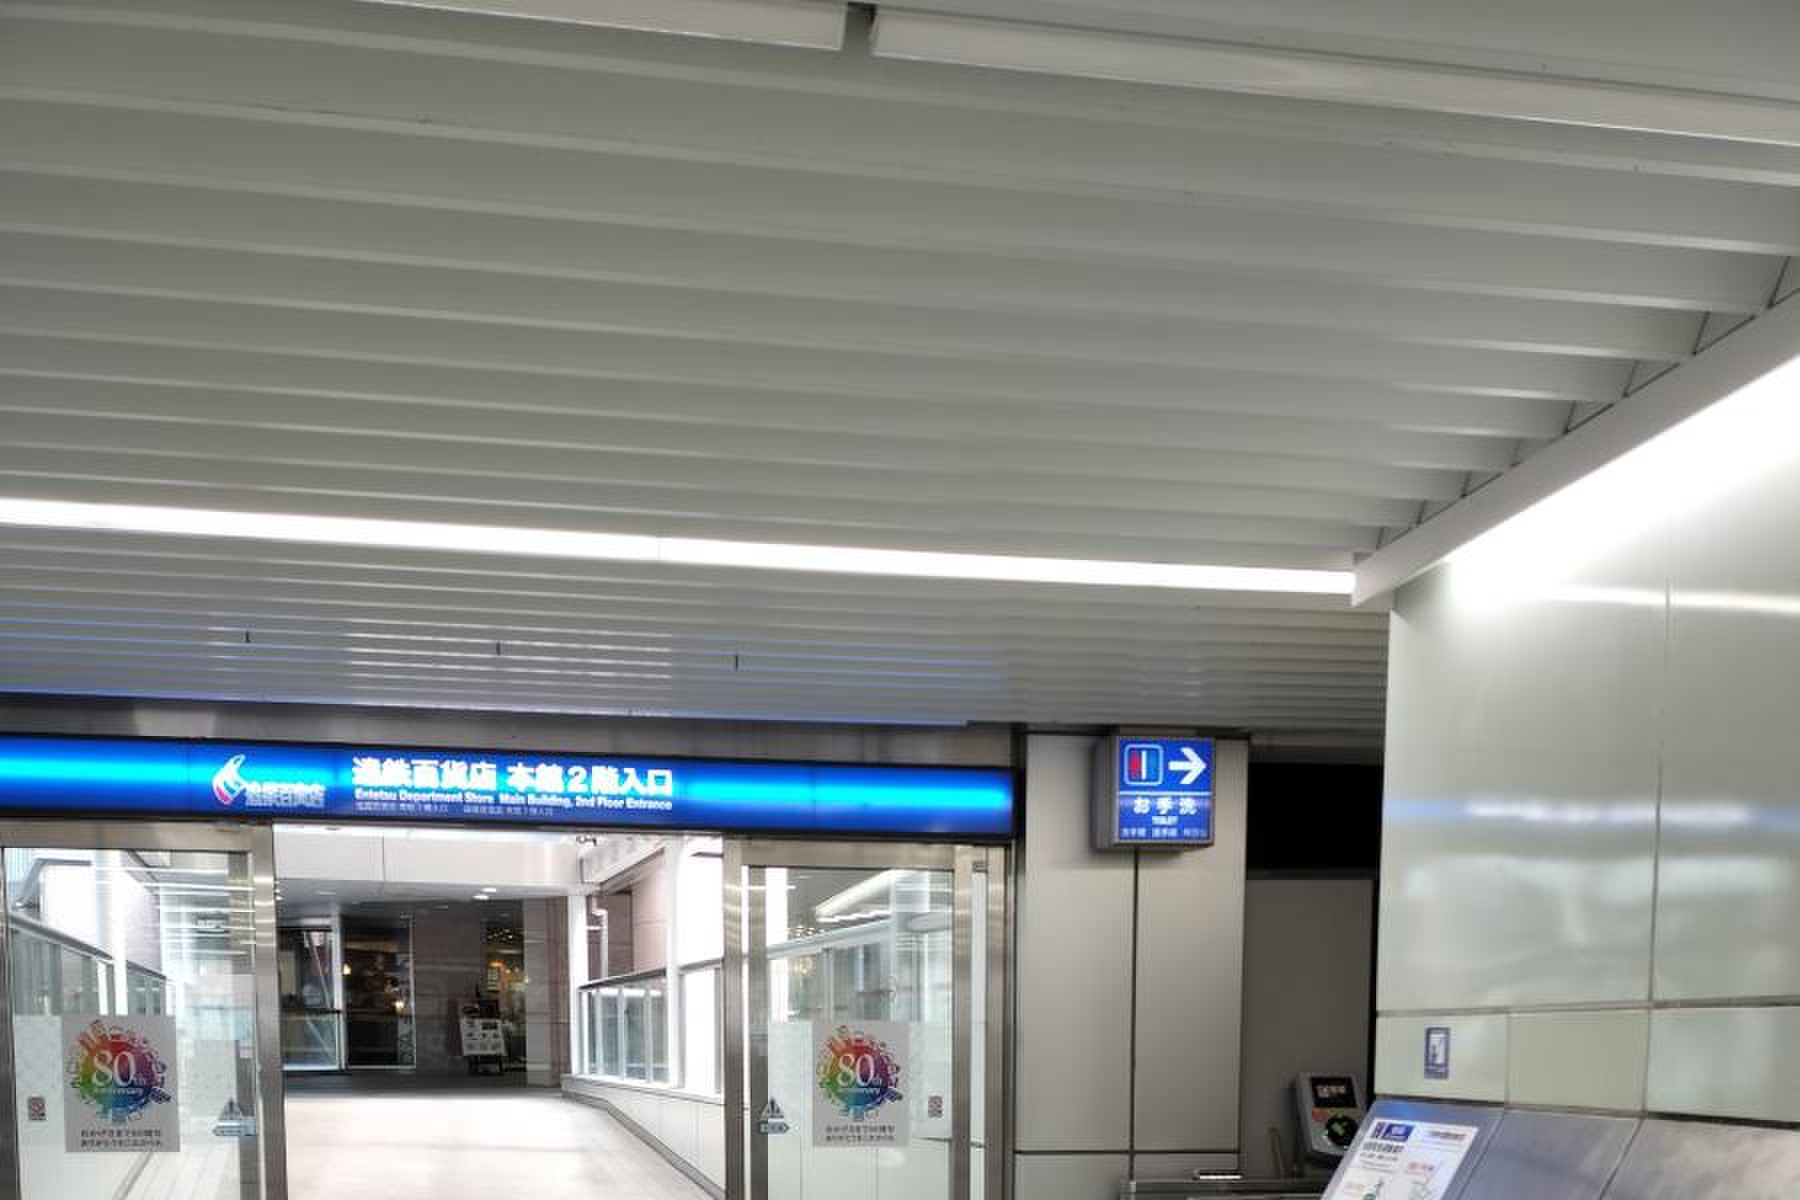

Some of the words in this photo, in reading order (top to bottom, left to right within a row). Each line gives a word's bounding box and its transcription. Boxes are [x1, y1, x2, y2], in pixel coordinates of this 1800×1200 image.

[399, 789, 463, 803] Department
[499, 793, 524, 804] Main
[597, 796, 624, 808] Floor
[626, 798, 673, 811] Entrance
